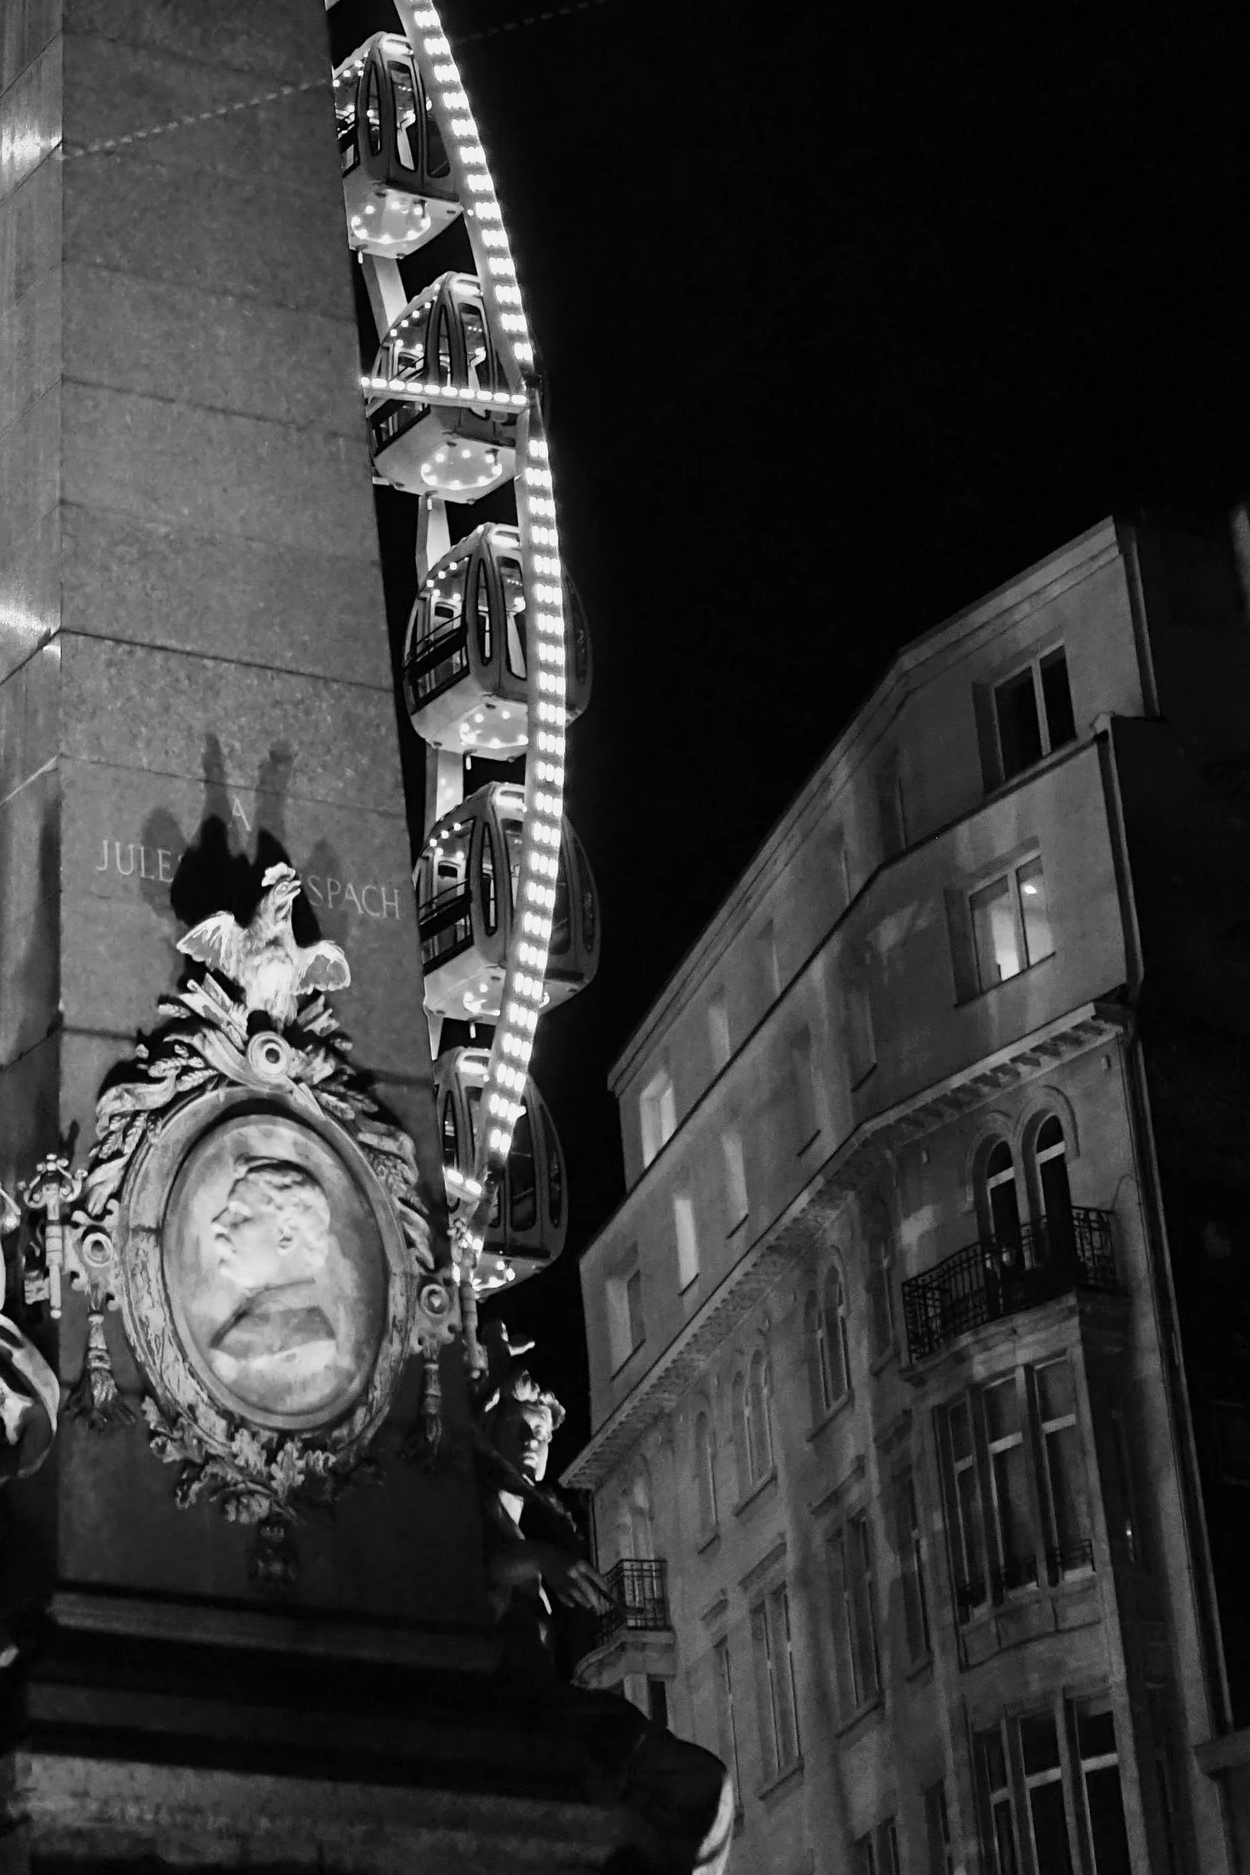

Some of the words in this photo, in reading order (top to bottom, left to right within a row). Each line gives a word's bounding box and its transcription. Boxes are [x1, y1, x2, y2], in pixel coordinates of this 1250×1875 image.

[228, 794, 251, 832] A
[95, 839, 186, 884] JULE
[299, 873, 400, 921] SPACH
